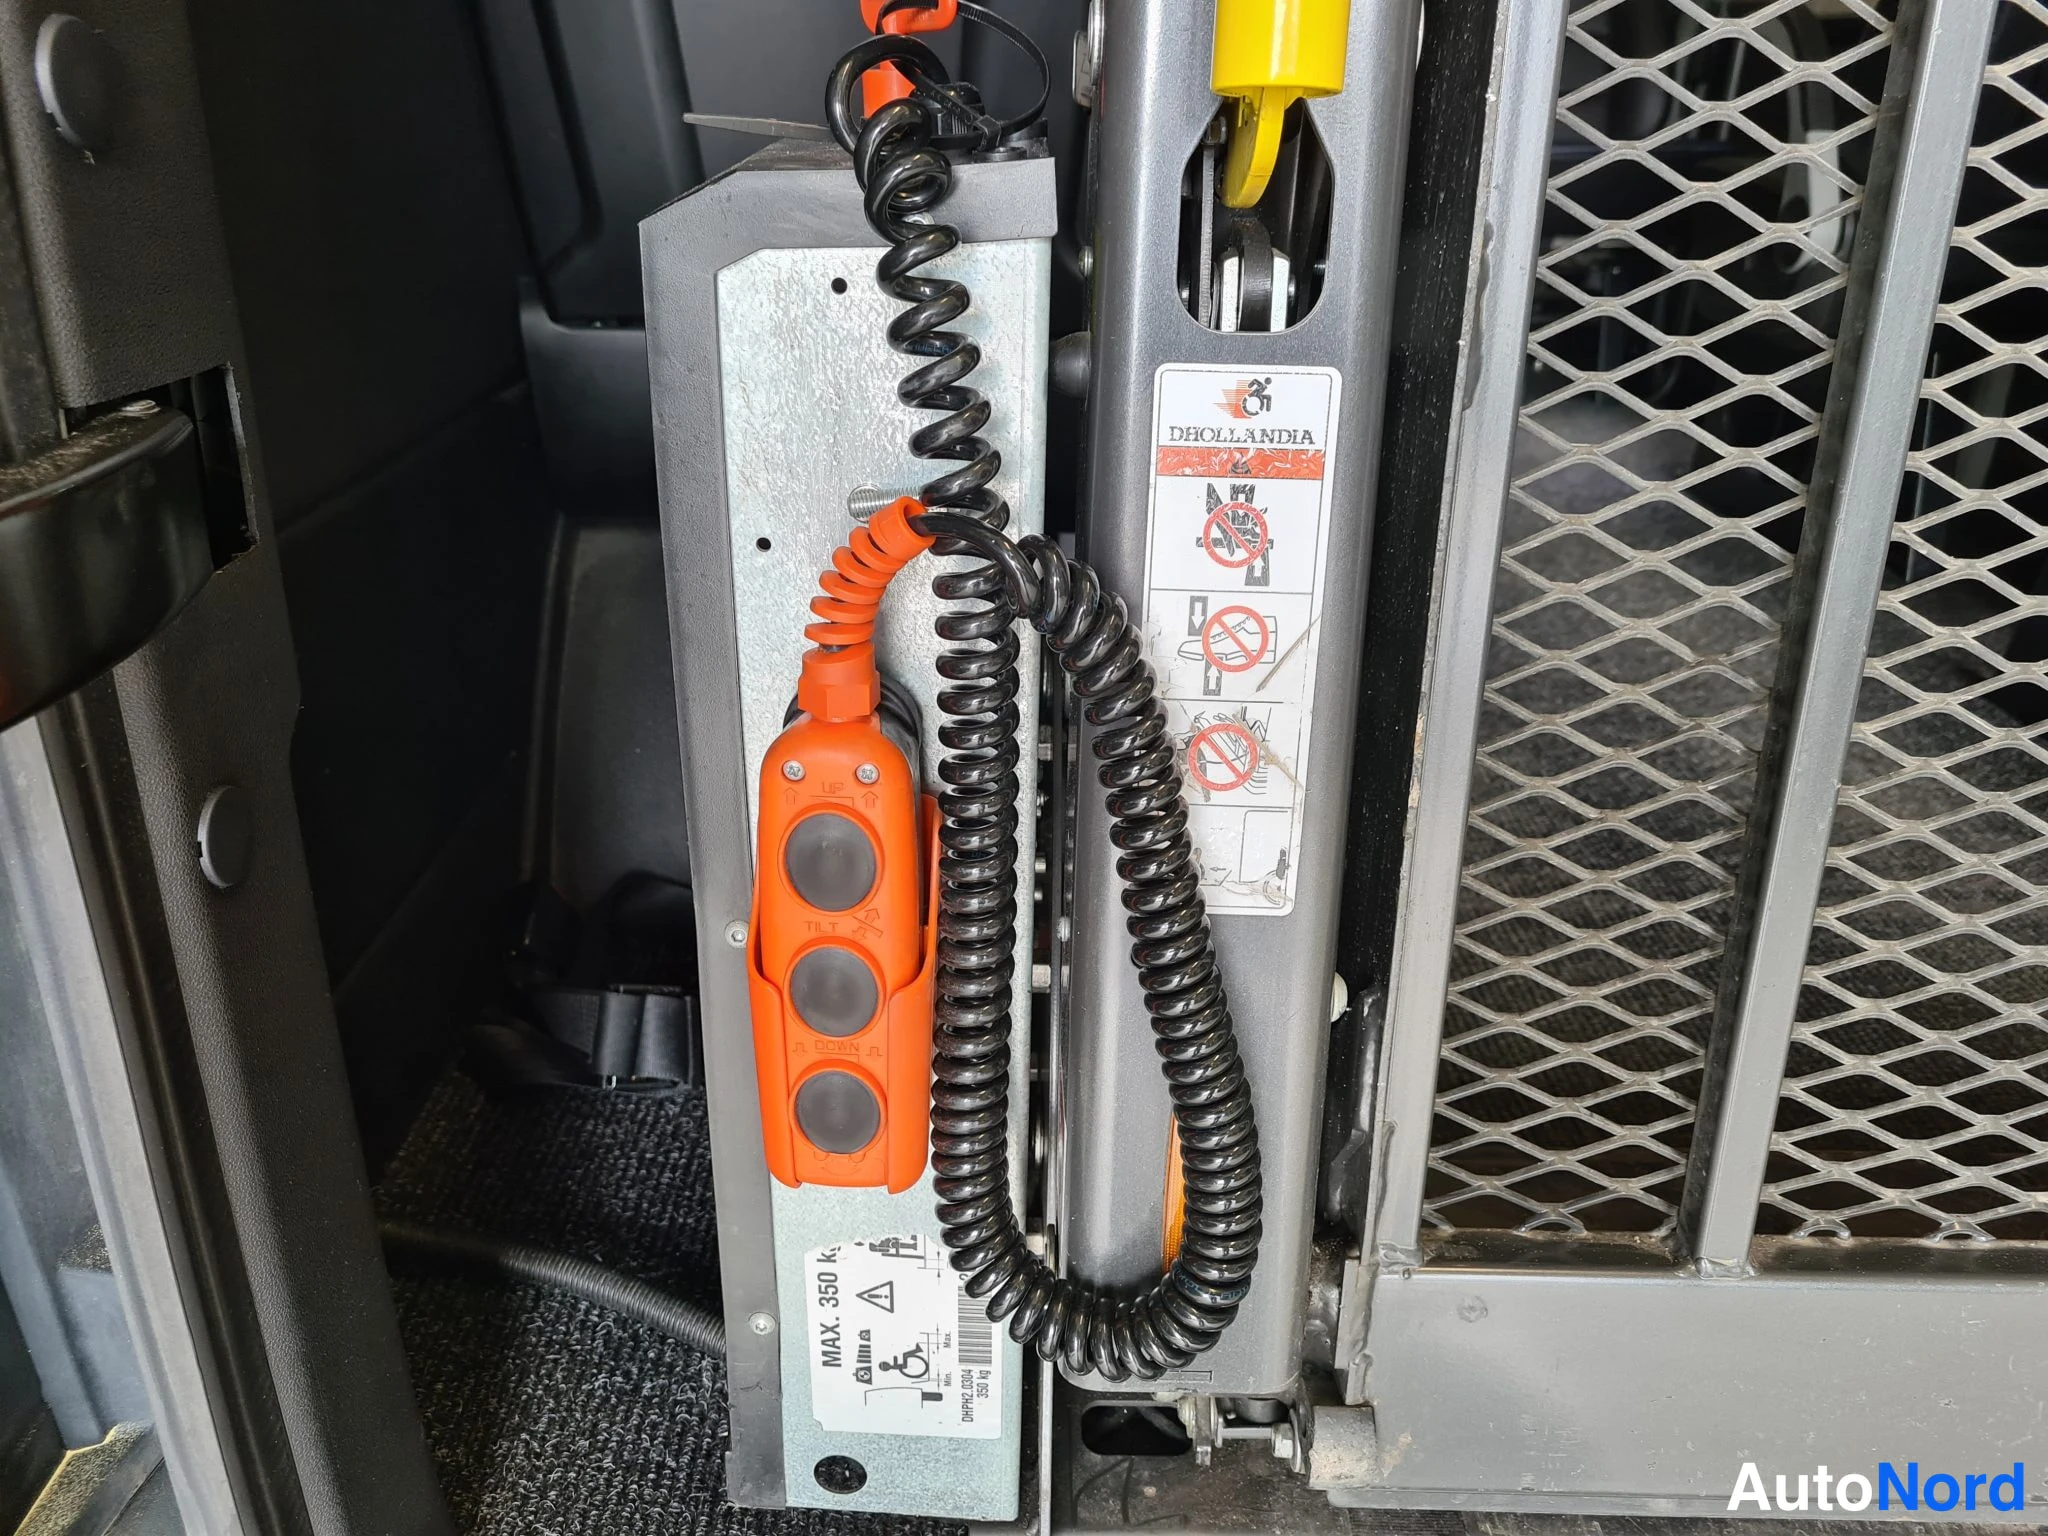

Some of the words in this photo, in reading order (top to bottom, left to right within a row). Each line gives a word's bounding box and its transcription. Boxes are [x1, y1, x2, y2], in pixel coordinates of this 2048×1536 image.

[1168, 426, 1316, 445] DHOLLANDIA
[822, 781, 844, 794] UP
[803, 920, 840, 933] TILT
[815, 1040, 860, 1053] DOWN
[816, 1245, 841, 1263] k
[816, 1271, 840, 1308] 350
[820, 1316, 842, 1368] MAX.
[943, 1371, 952, 1387] Min.
[976, 1369, 992, 1380] kg
[961, 1368, 974, 1422] DHPH2.0304
[976, 1382, 989, 1399] 350
